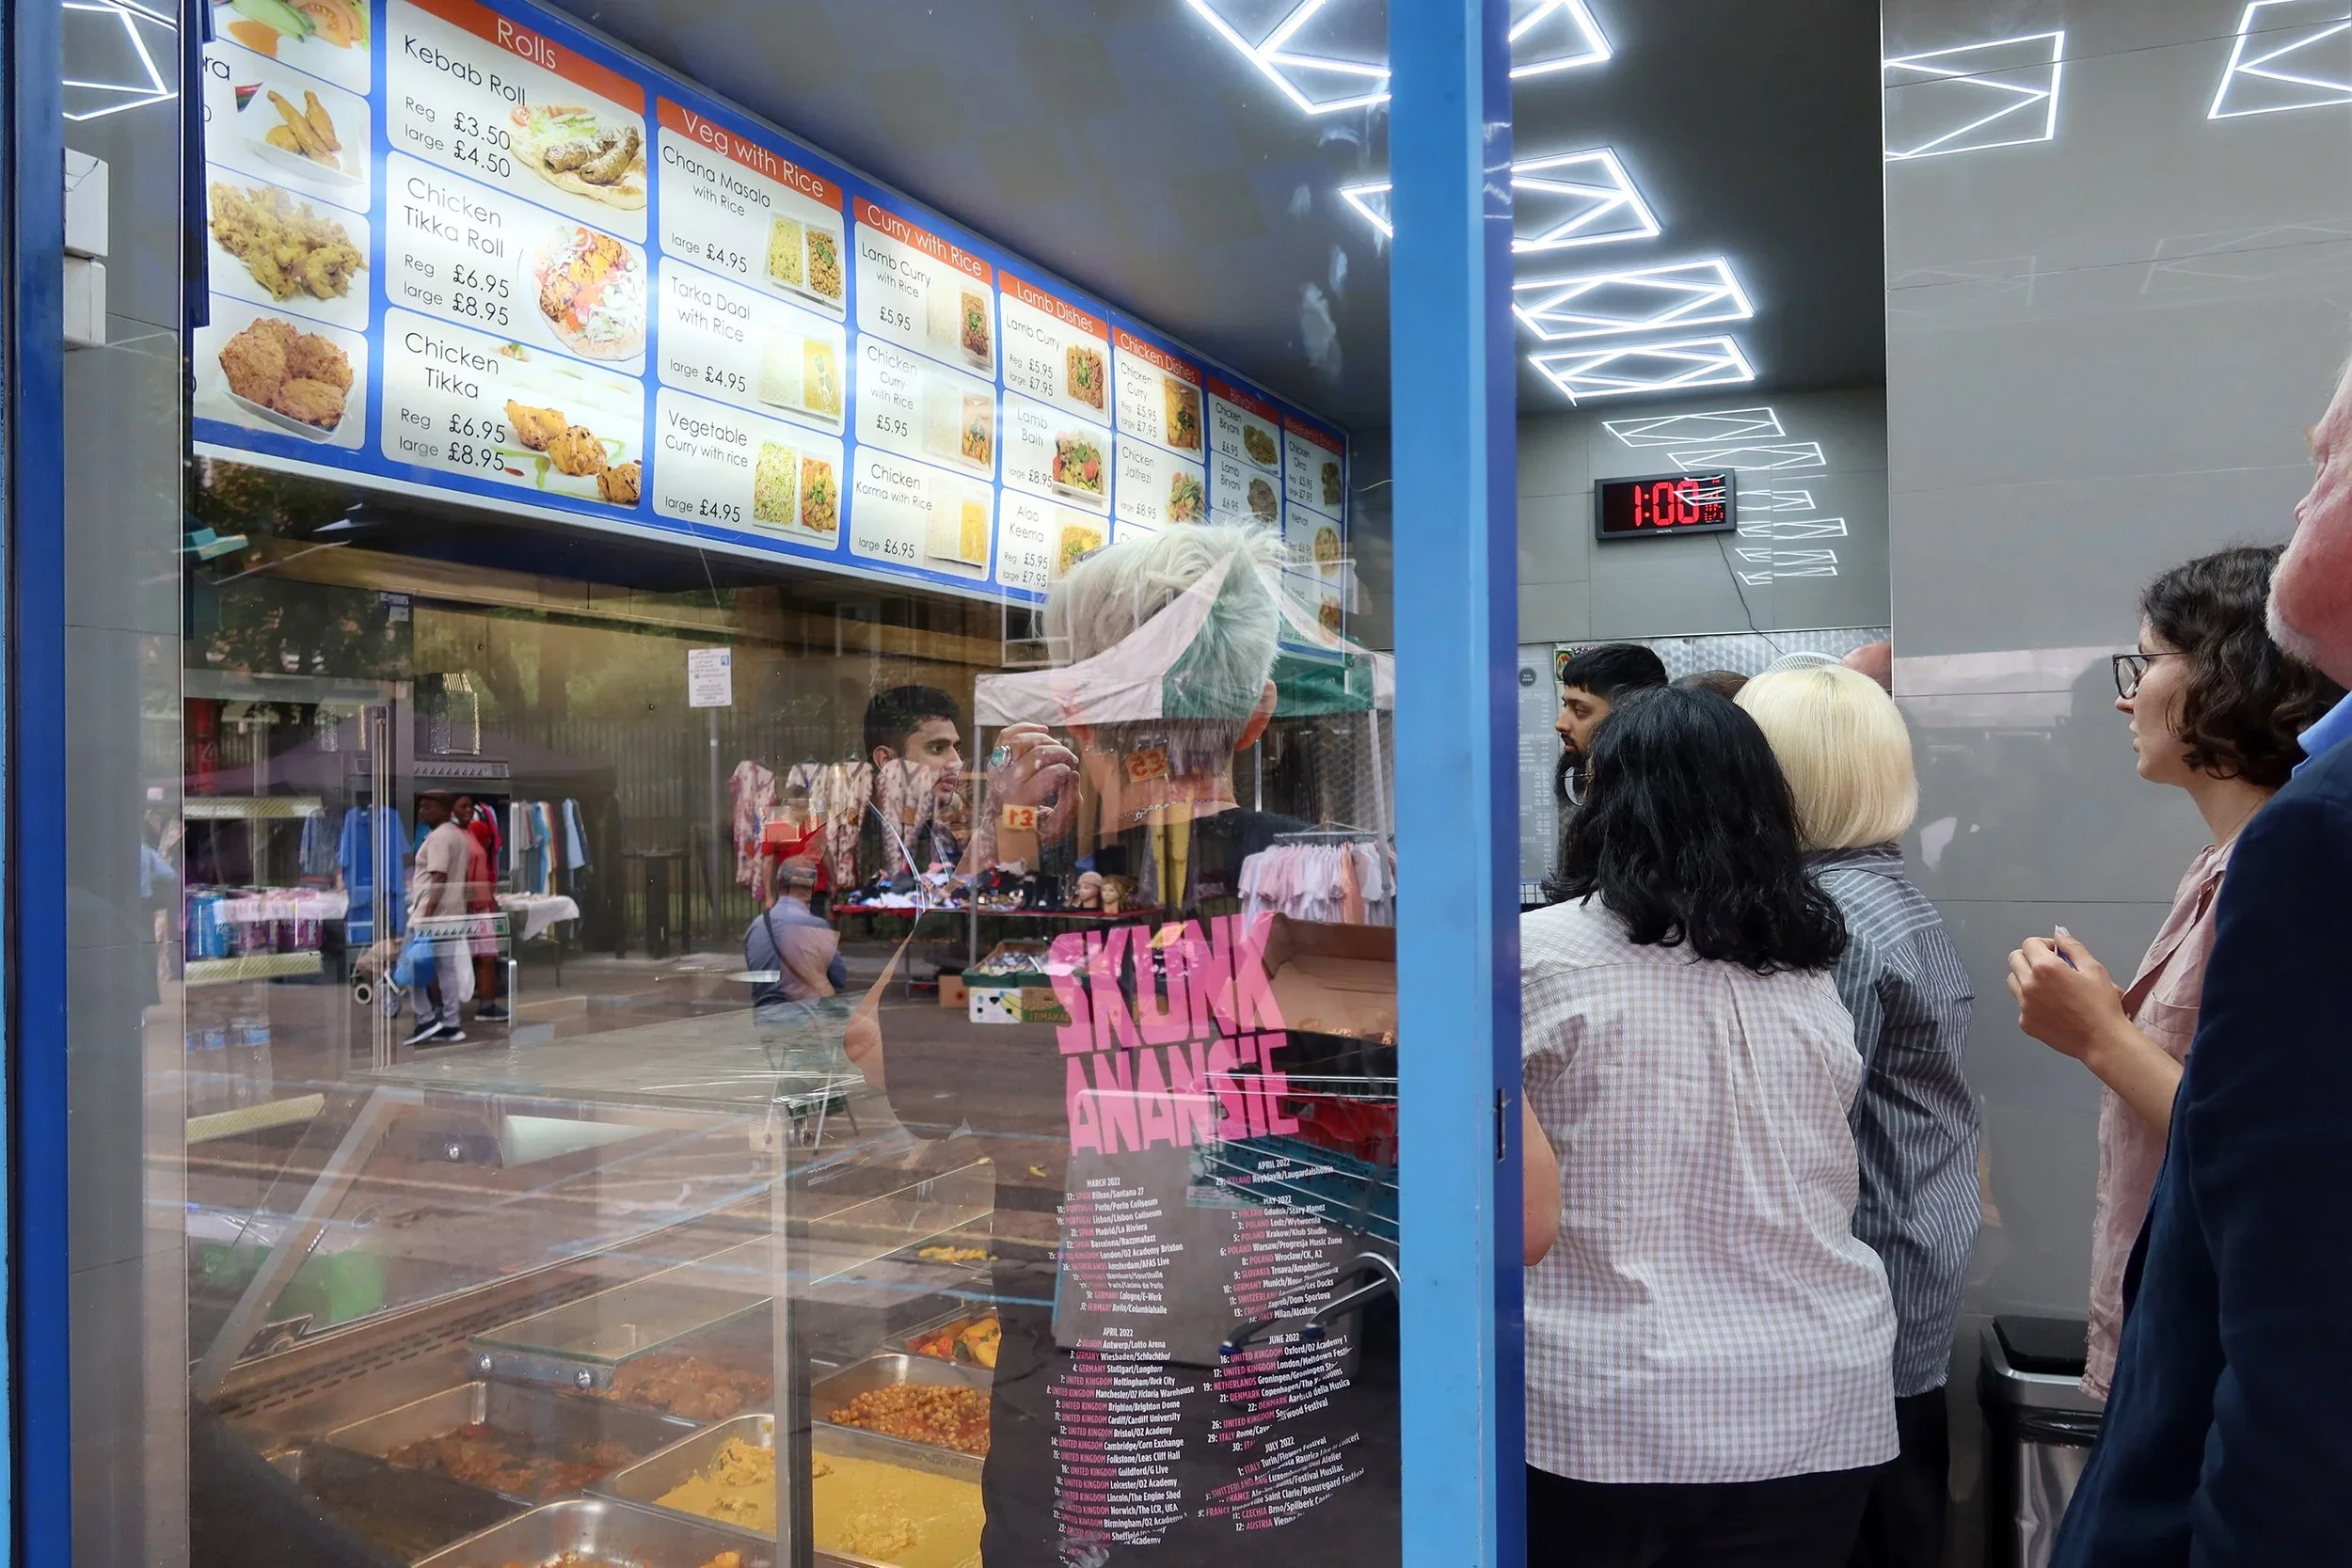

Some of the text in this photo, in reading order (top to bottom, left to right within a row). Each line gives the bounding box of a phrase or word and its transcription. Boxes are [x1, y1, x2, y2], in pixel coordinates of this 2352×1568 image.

[497, 19, 557, 70] Rolls
[405, 36, 526, 107] Kebab Roll
[405, 97, 511, 151] Reg £3.50
[405, 124, 511, 179] large £4.50
[682, 109, 824, 198] Veg with Rice
[662, 145, 771, 208] Chana Masala
[407, 178, 501, 229] Chicken
[693, 184, 745, 216] with Rice
[405, 205, 504, 259] Tikka Roll
[867, 205, 983, 277] Curry with Rice
[672, 233, 748, 274] large £4.95
[862, 242, 931, 289] Lamb Curry
[405, 254, 510, 298] Reg £6.95
[876, 270, 919, 298] with Rice
[404, 281, 510, 326] large £8.95
[671, 277, 750, 321] Tarka Daal
[1017, 281, 1093, 333] Lamb Dishes
[677, 308, 744, 342] with Rice
[880, 306, 911, 331] £5.95
[1007, 314, 1059, 352] Lamb Curry
[405, 331, 500, 376] Chicken
[867, 345, 917, 376] Chicken
[1120, 333, 1196, 383] Chicken Dishes
[670, 357, 746, 393] large £4.95
[1009, 354, 1054, 379] Reg £5.95
[1120, 362, 1152, 387] Chicken
[425, 368, 479, 400] Tikka
[880, 371, 905, 390] Curry
[1009, 371, 1054, 397] large £7.95
[1127, 382, 1148, 402] Curry
[870, 386, 914, 411] with Rice
[1230, 388, 1257, 413] Biryani
[1017, 406, 1048, 430] Lamb
[1136, 404, 1157, 422] £5.95
[1216, 402, 1242, 423] Chicken
[401, 408, 506, 444] Reg £6.95
[668, 409, 747, 447] Vegetable
[877, 414, 908, 437] £5.95
[1022, 428, 1043, 448] Balti
[1137, 420, 1157, 438] £7.95
[1219, 417, 1240, 436] Biryani
[399, 436, 505, 471] large £8.95
[665, 435, 748, 467] Curry with rice
[1121, 446, 1154, 468] Chicken
[1222, 440, 1239, 457] £6.95
[871, 464, 921, 490] Chicken
[1009, 467, 1053, 488] large £8.95
[1125, 465, 1152, 484] Jalfrezi
[1221, 461, 1240, 478] Lamb
[1221, 474, 1241, 492] Biryani
[855, 481, 932, 511] Korma with Rice
[1635, 481, 1699, 527] 1:00
[665, 496, 740, 523] large £4.95
[1017, 506, 1039, 522] Aloo
[1136, 502, 1157, 520] £8.95
[1009, 522, 1043, 543] Keema
[858, 536, 915, 559] large £6.95
[1004, 551, 1048, 570] Reg £5.95
[1002, 570, 1047, 588] large £7.95
[1048, 911, 1286, 1054] SKUNK
[1066, 1033, 1299, 1156] ANANSIE
[1258, 1158, 1291, 1170] APRIL 2022
[1087, 1178, 1121, 1188] MARCH 2022
[1220, 1248, 1227, 1257] 6:
[1228, 1244, 1252, 1255] POLAND
[1309, 1238, 1326, 1246] Music
[1327, 1237, 1343, 1245] Zone
[1242, 1257, 1248, 1266] 8:
[1249, 1255, 1274, 1265] POLAND
[1314, 1250, 1323, 1259] A2
[1103, 1327, 1134, 1337] APRIL 2022
[1269, 1333, 1299, 1345] JUNE 2022
[1220, 1354, 1230, 1364] 16:
[1231, 1352, 1253, 1363] UNITED
[1254, 1348, 1283, 1360] KINGDOM
[1316, 1337, 1343, 1350] Academy
[1056, 1400, 1060, 1408] 9:
[1062, 1401, 1081, 1410] UNITED
[1082, 1402, 1107, 1411] KINGDOM
[1162, 1400, 1181, 1409] Dome
[1062, 1413, 1081, 1422] UNITED
[1082, 1414, 1107, 1424] KINGDOM
[1150, 1412, 1181, 1423] University
[1264, 1436, 1295, 1453] JULY 2022
[1070, 1465, 1089, 1476] UNITED
[1090, 1466, 1117, 1477] KINGDOM
[1155, 1465, 1168, 1474] Live
[1241, 1507, 1268, 1519] CZECHIA
